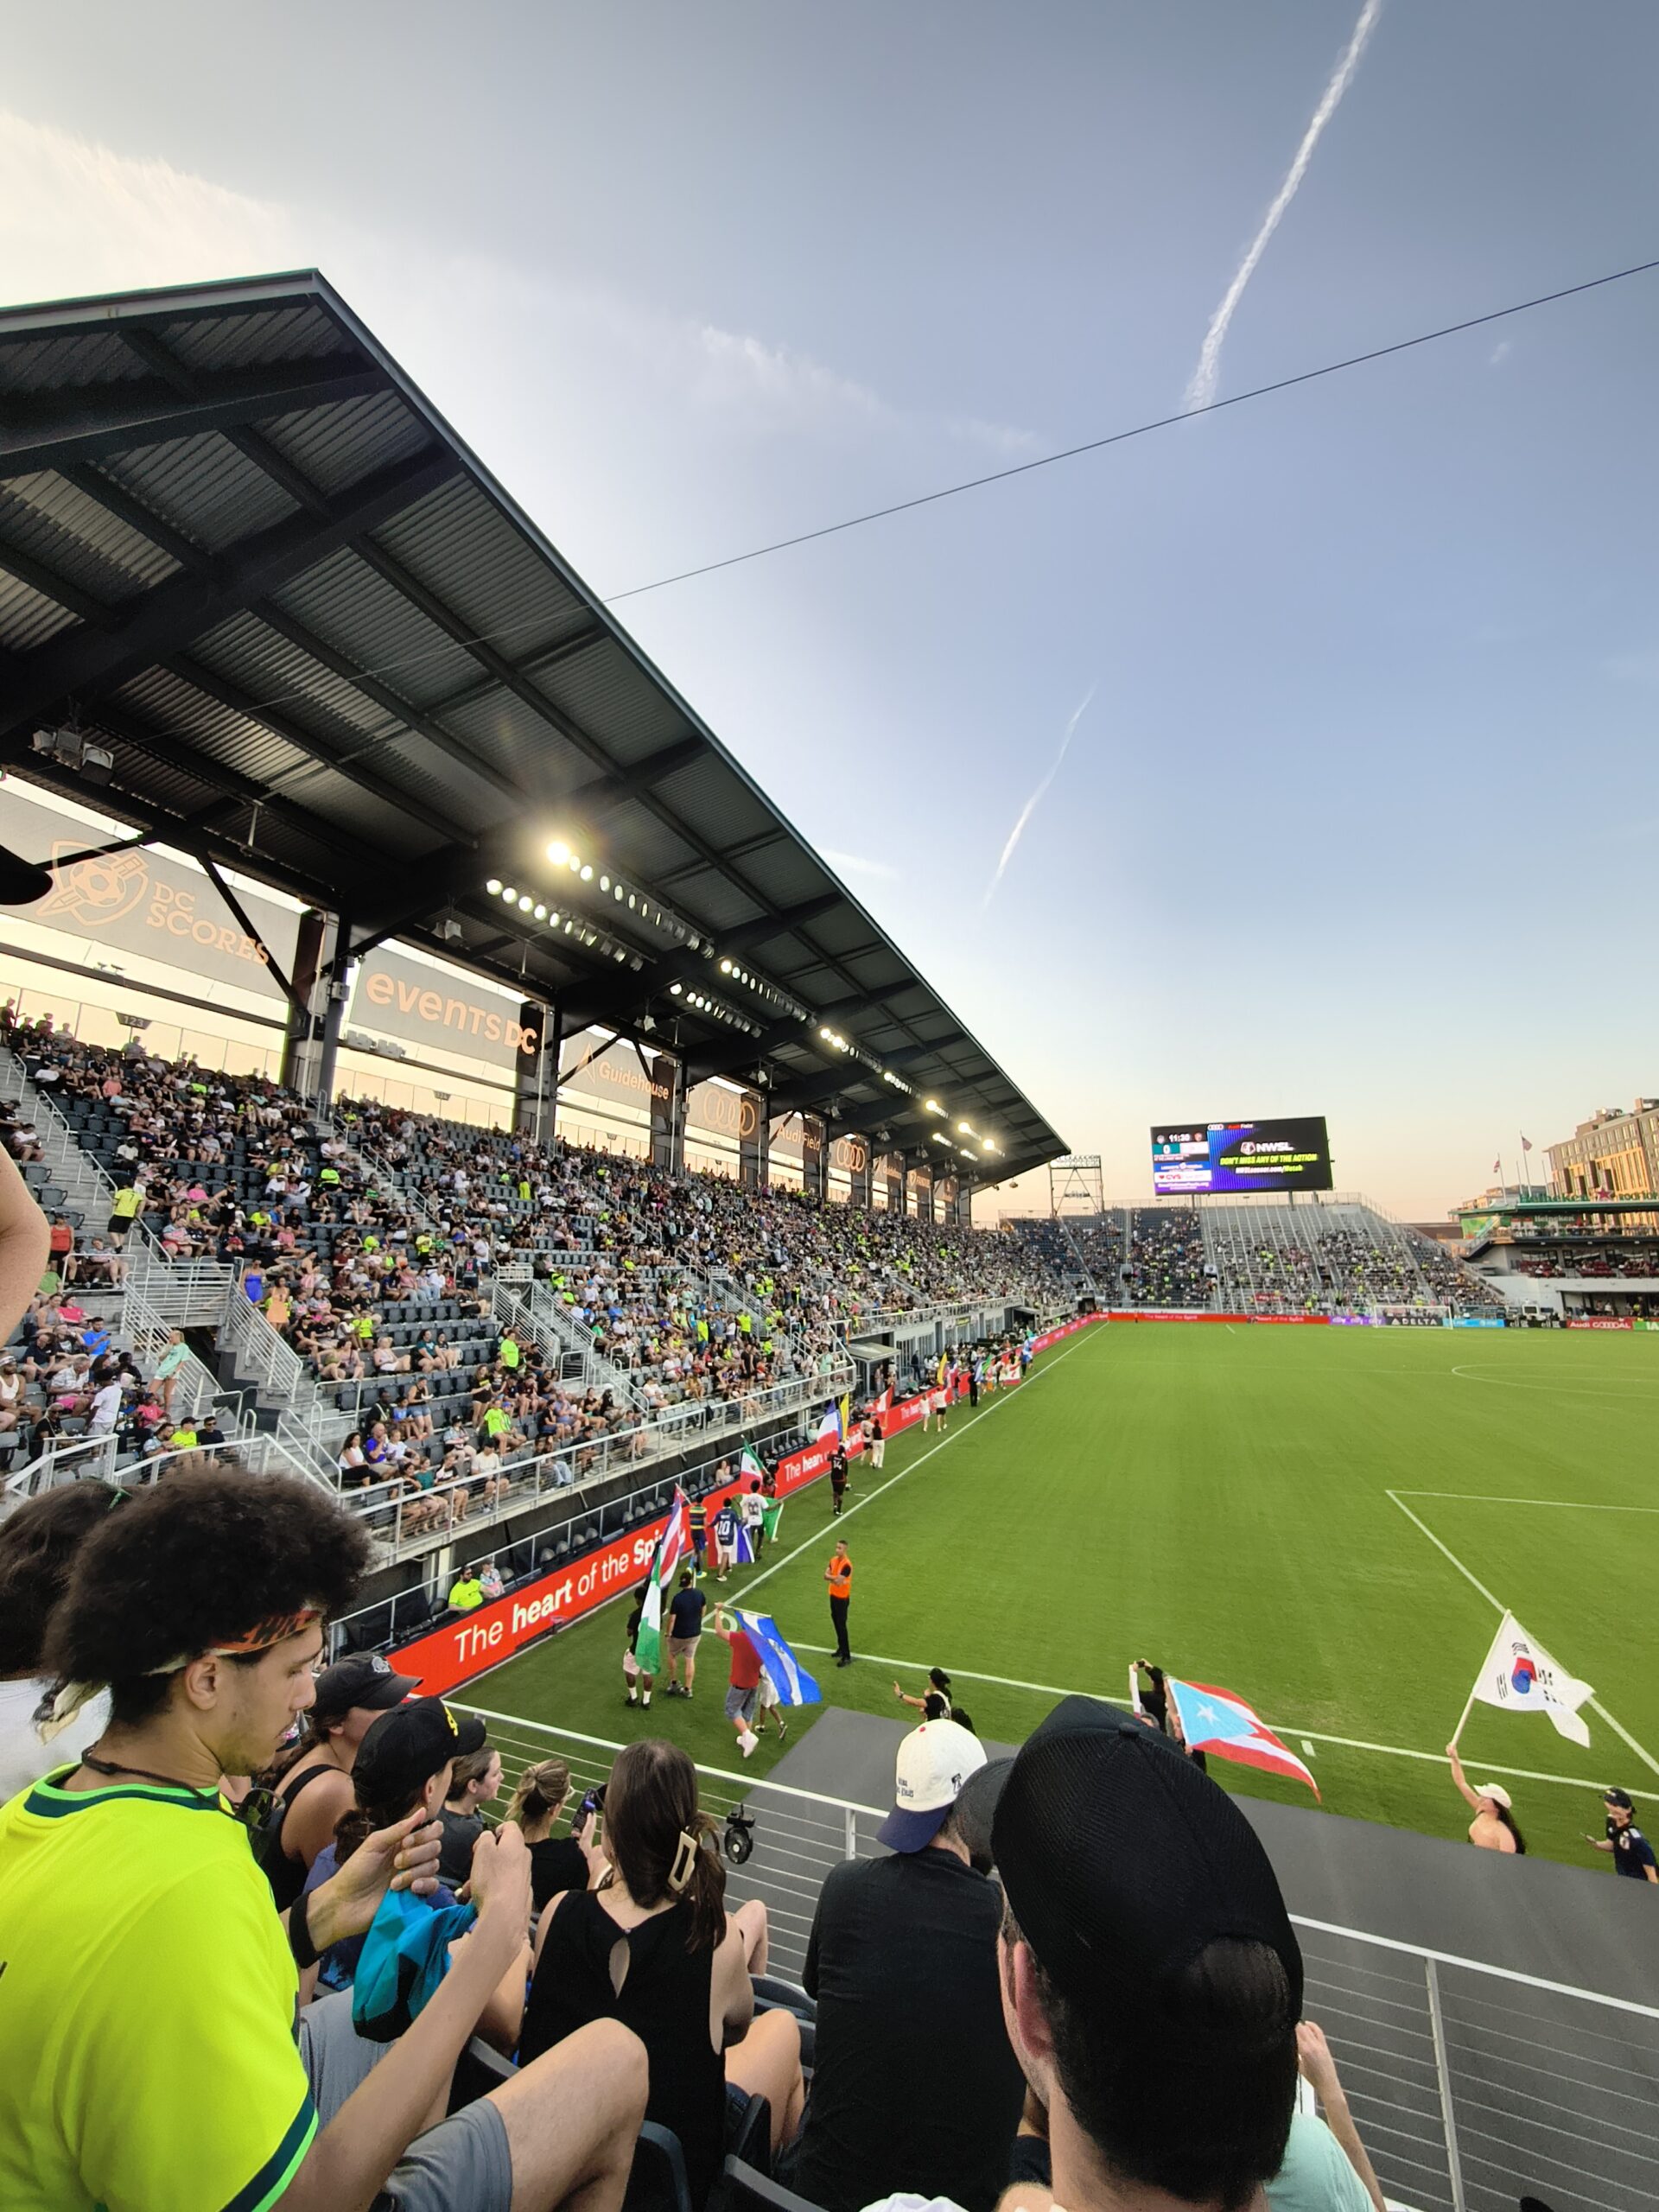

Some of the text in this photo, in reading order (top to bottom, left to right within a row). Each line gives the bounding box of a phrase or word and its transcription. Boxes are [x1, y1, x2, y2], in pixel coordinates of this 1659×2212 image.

[152, 881, 195, 912] DC
[146, 902, 270, 966] SCORES
[124, 1015, 144, 1027] 123
[598, 1061, 670, 1101] Guidehouse
[778, 1124, 822, 1152] Audi Field
[1255, 1141, 1295, 1153] NWSL
[785, 1461, 802, 1483] The
[718, 1521, 731, 1535] 10
[454, 1620, 504, 1662] The
[512, 1581, 573, 1635] heart
[577, 1567, 598, 1597] of
[601, 1552, 629, 1583] the
